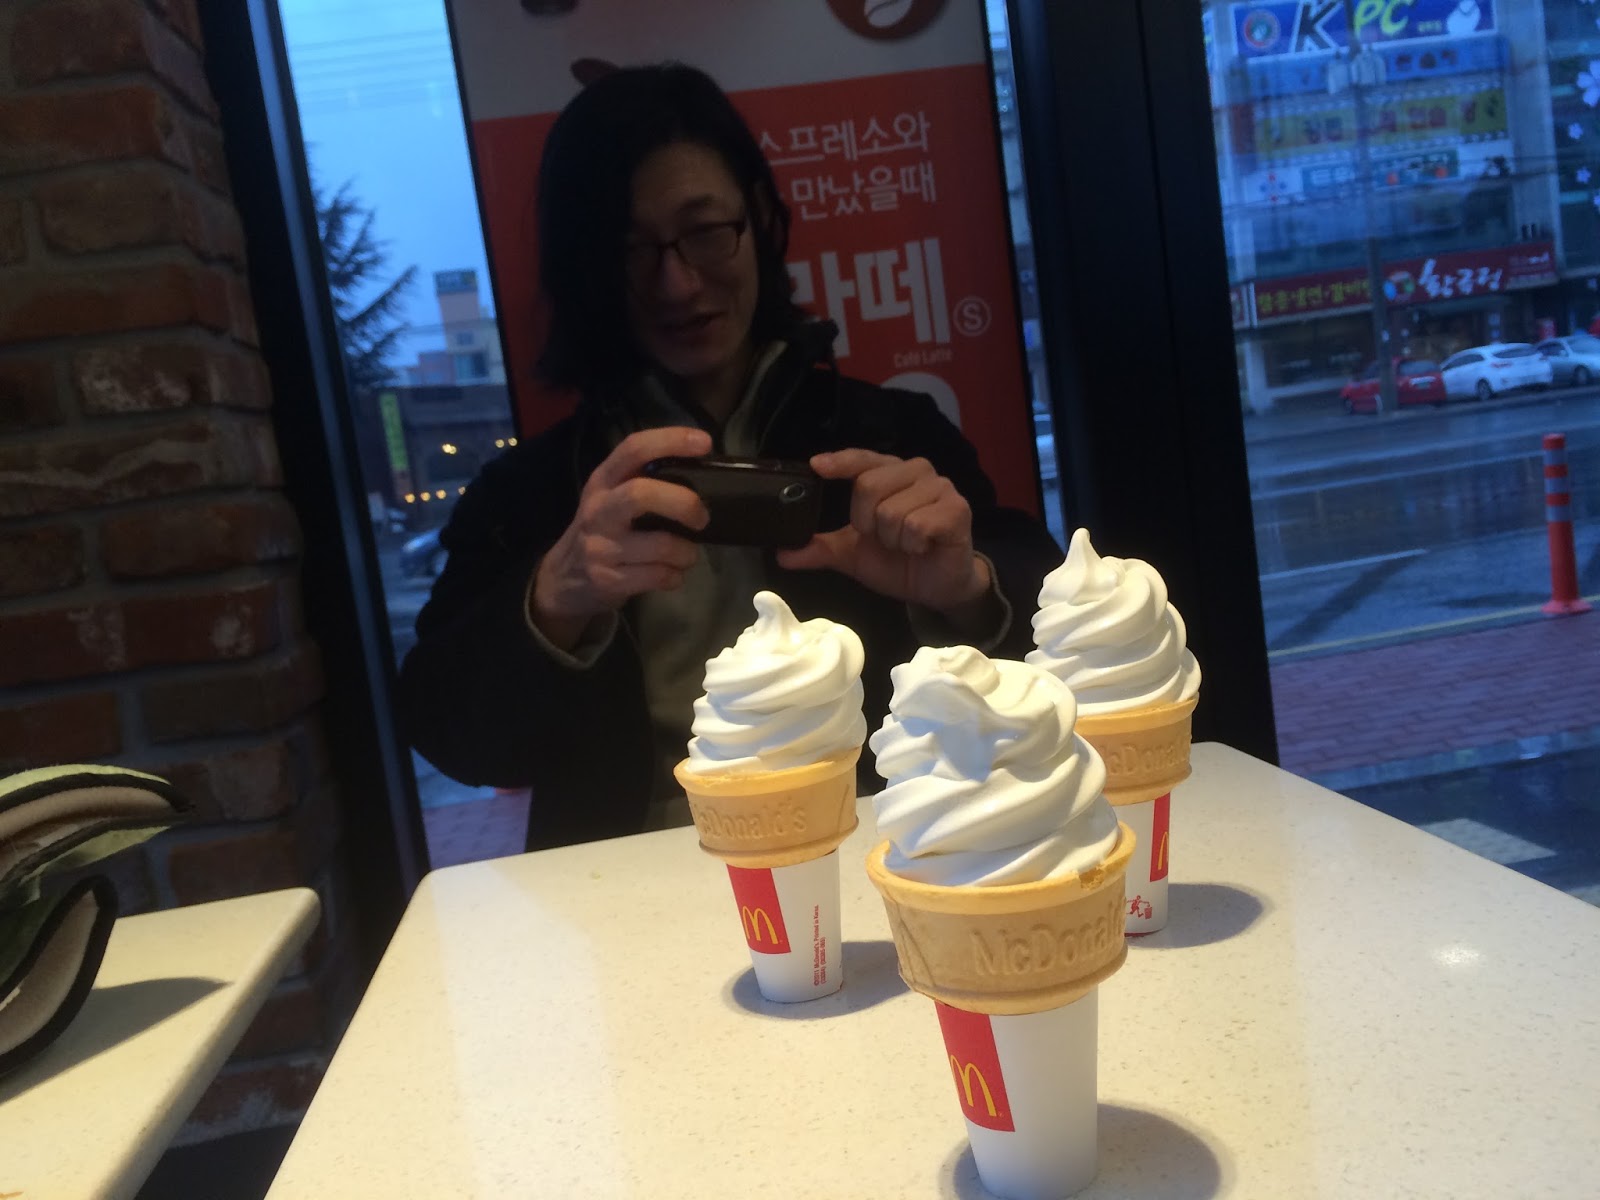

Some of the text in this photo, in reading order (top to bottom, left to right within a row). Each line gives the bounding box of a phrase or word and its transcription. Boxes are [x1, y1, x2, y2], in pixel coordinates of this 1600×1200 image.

[1293, 0, 1412, 51] K PC
[791, 161, 937, 220] 만났을때
